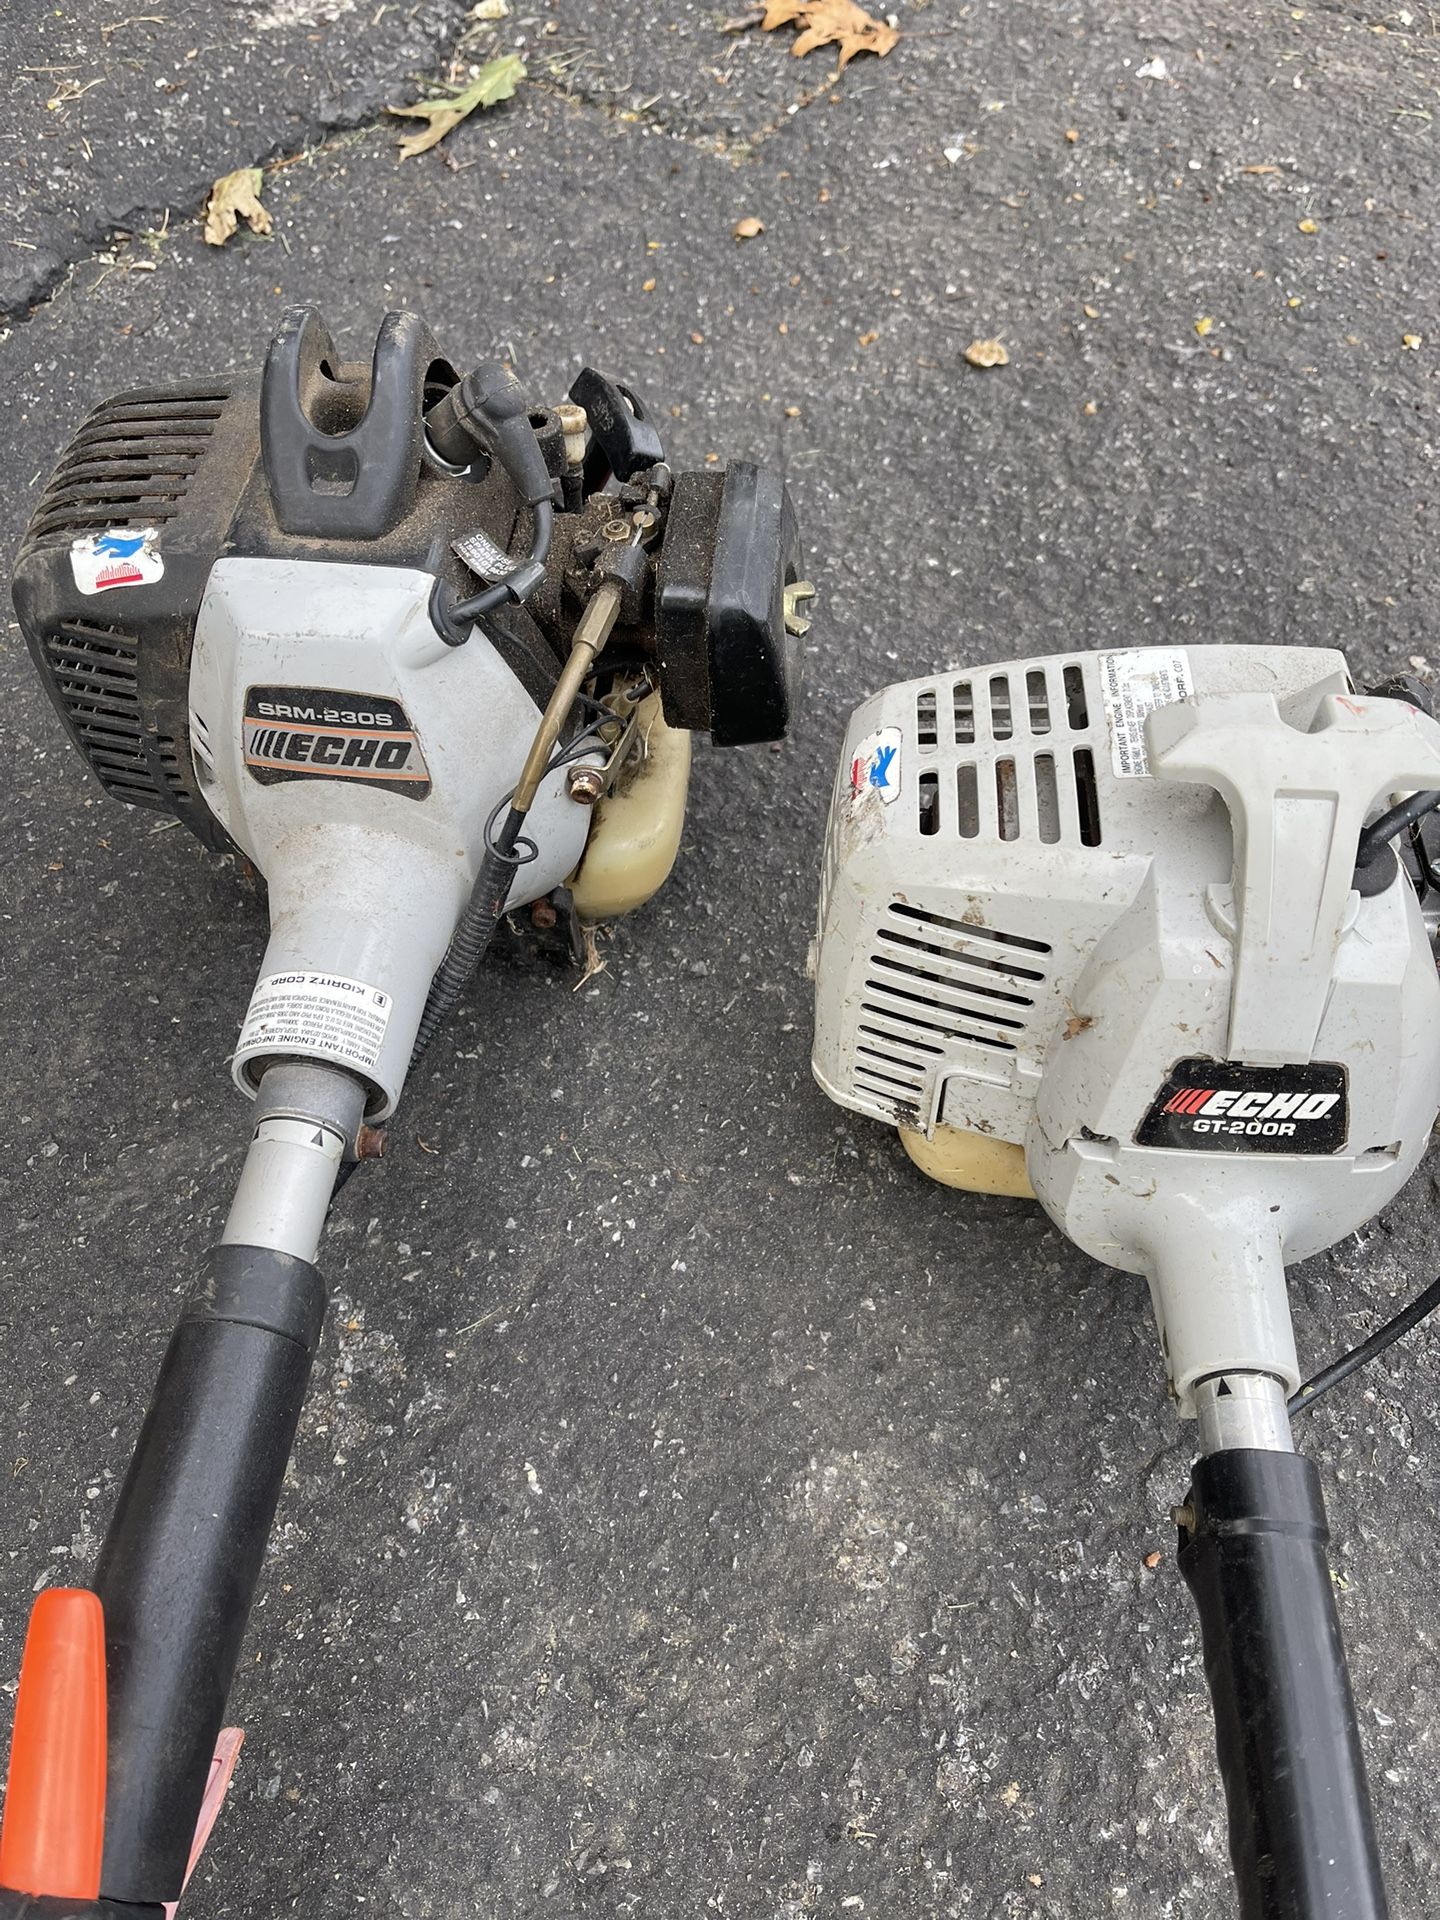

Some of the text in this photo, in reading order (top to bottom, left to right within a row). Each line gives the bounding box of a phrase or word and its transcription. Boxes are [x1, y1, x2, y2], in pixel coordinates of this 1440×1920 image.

[468, 536, 496, 564] SPARK
[475, 533, 497, 555] ONLY
[1176, 674, 1187, 699] ORP.
[257, 702, 393, 726] SRM-230S
[1106, 655, 1131, 773] IMPORTANT ENGINE INFORMATION
[284, 733, 412, 769] ECHO
[270, 976, 305, 986] CORP.
[309, 977, 365, 995] KIORITZ
[277, 1035, 316, 1045] ENGINE
[318, 1040, 375, 1066] IMPORTANT
[1199, 1090, 1341, 1120] ECHO
[1193, 1119, 1297, 1136] GT-200R
